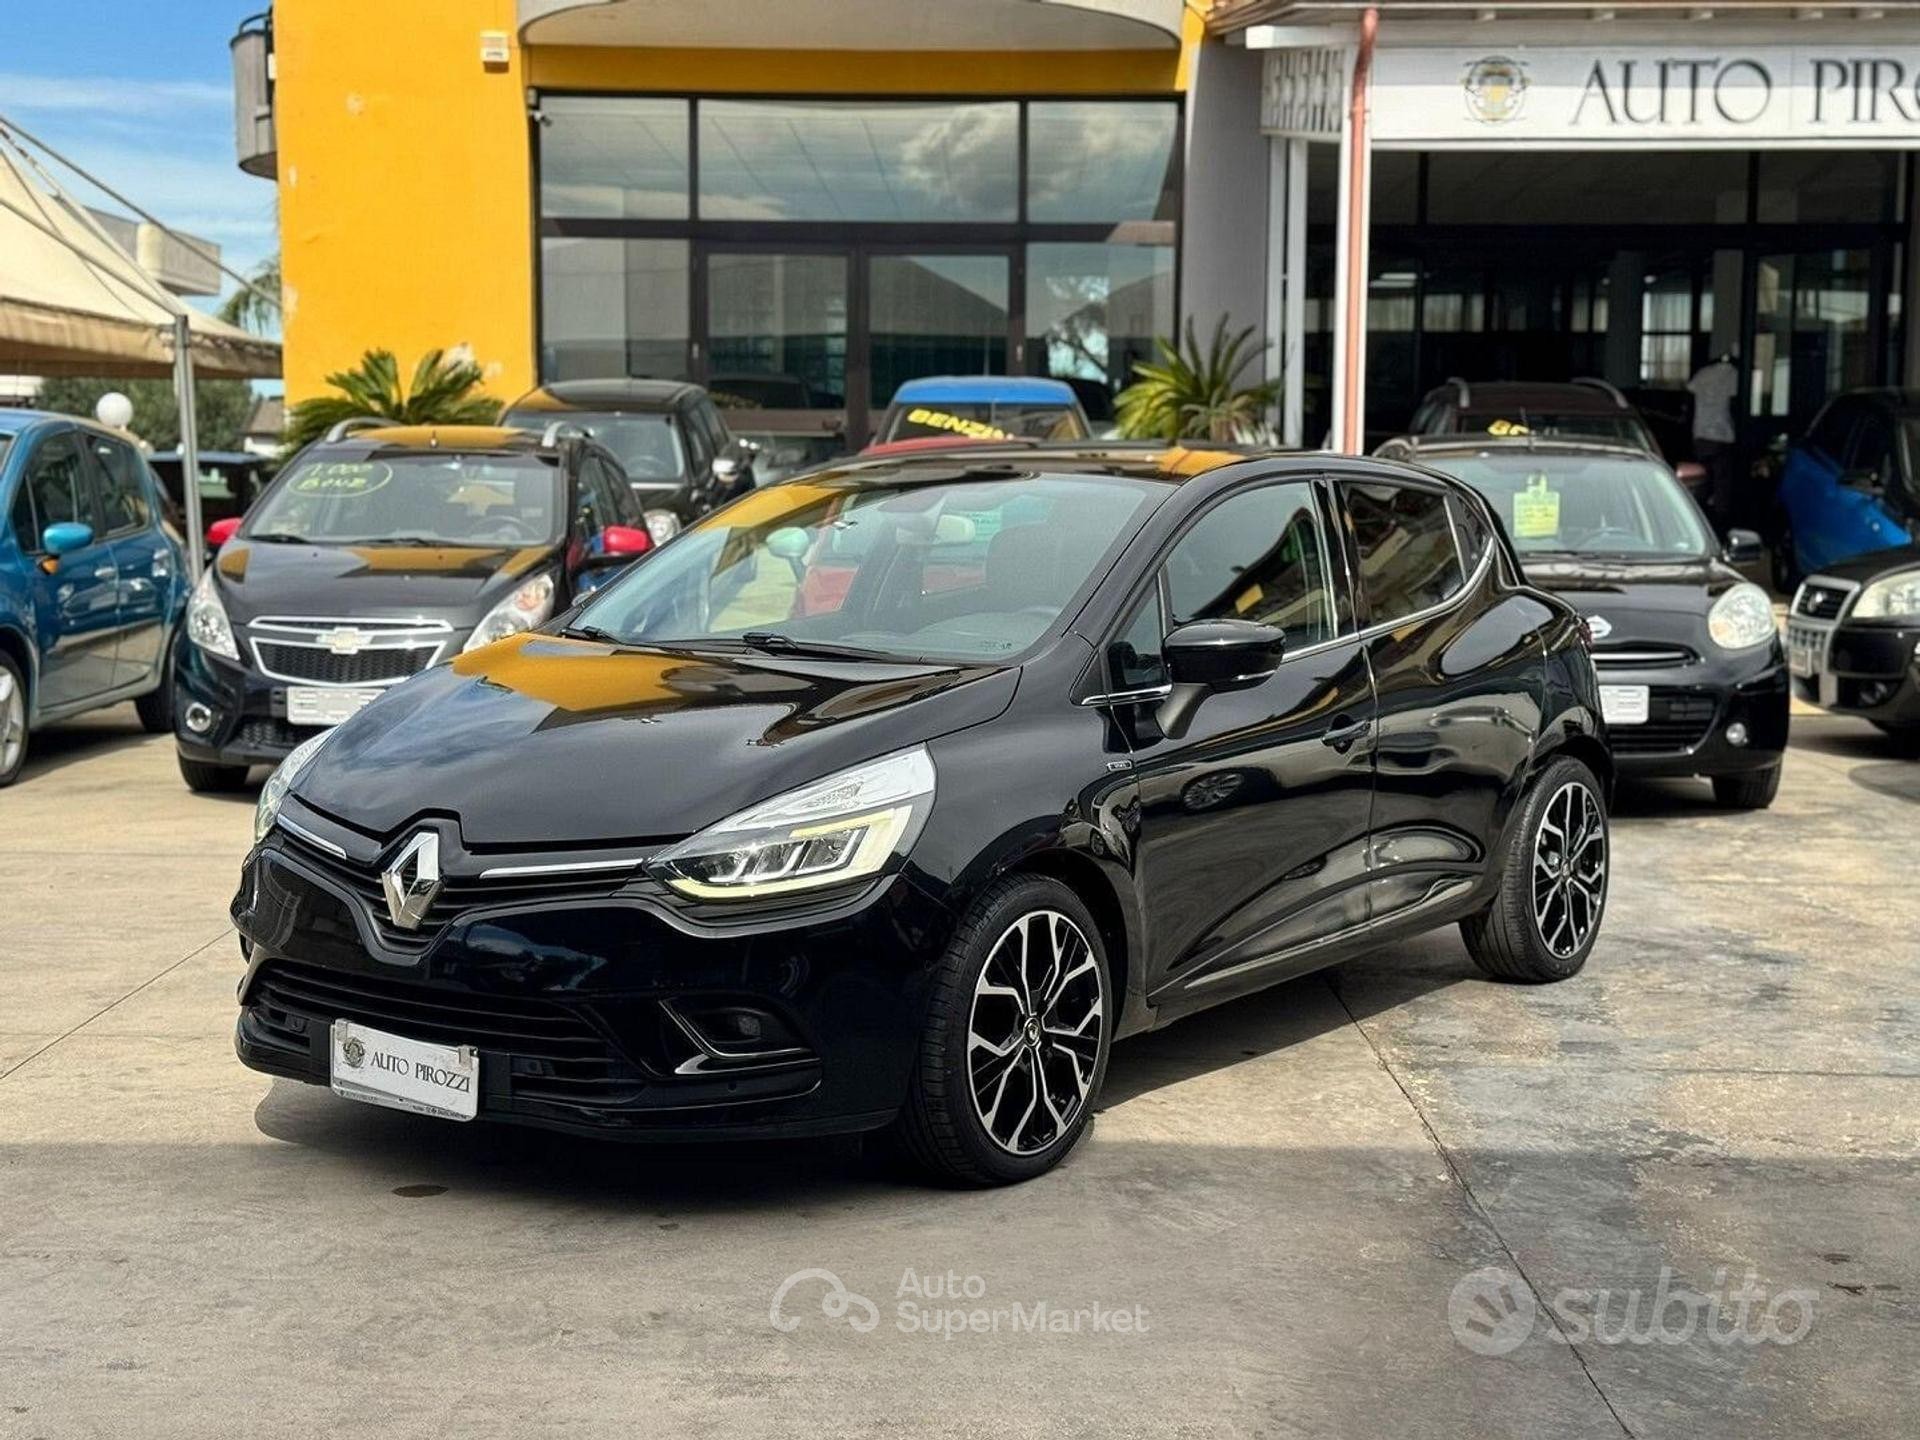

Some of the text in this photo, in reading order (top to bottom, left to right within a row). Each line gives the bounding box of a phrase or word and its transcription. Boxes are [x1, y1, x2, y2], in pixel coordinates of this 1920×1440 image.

[1568, 57, 1920, 125] AUTO PIR
[371, 1051, 471, 1093] AUTO PIROZZI
